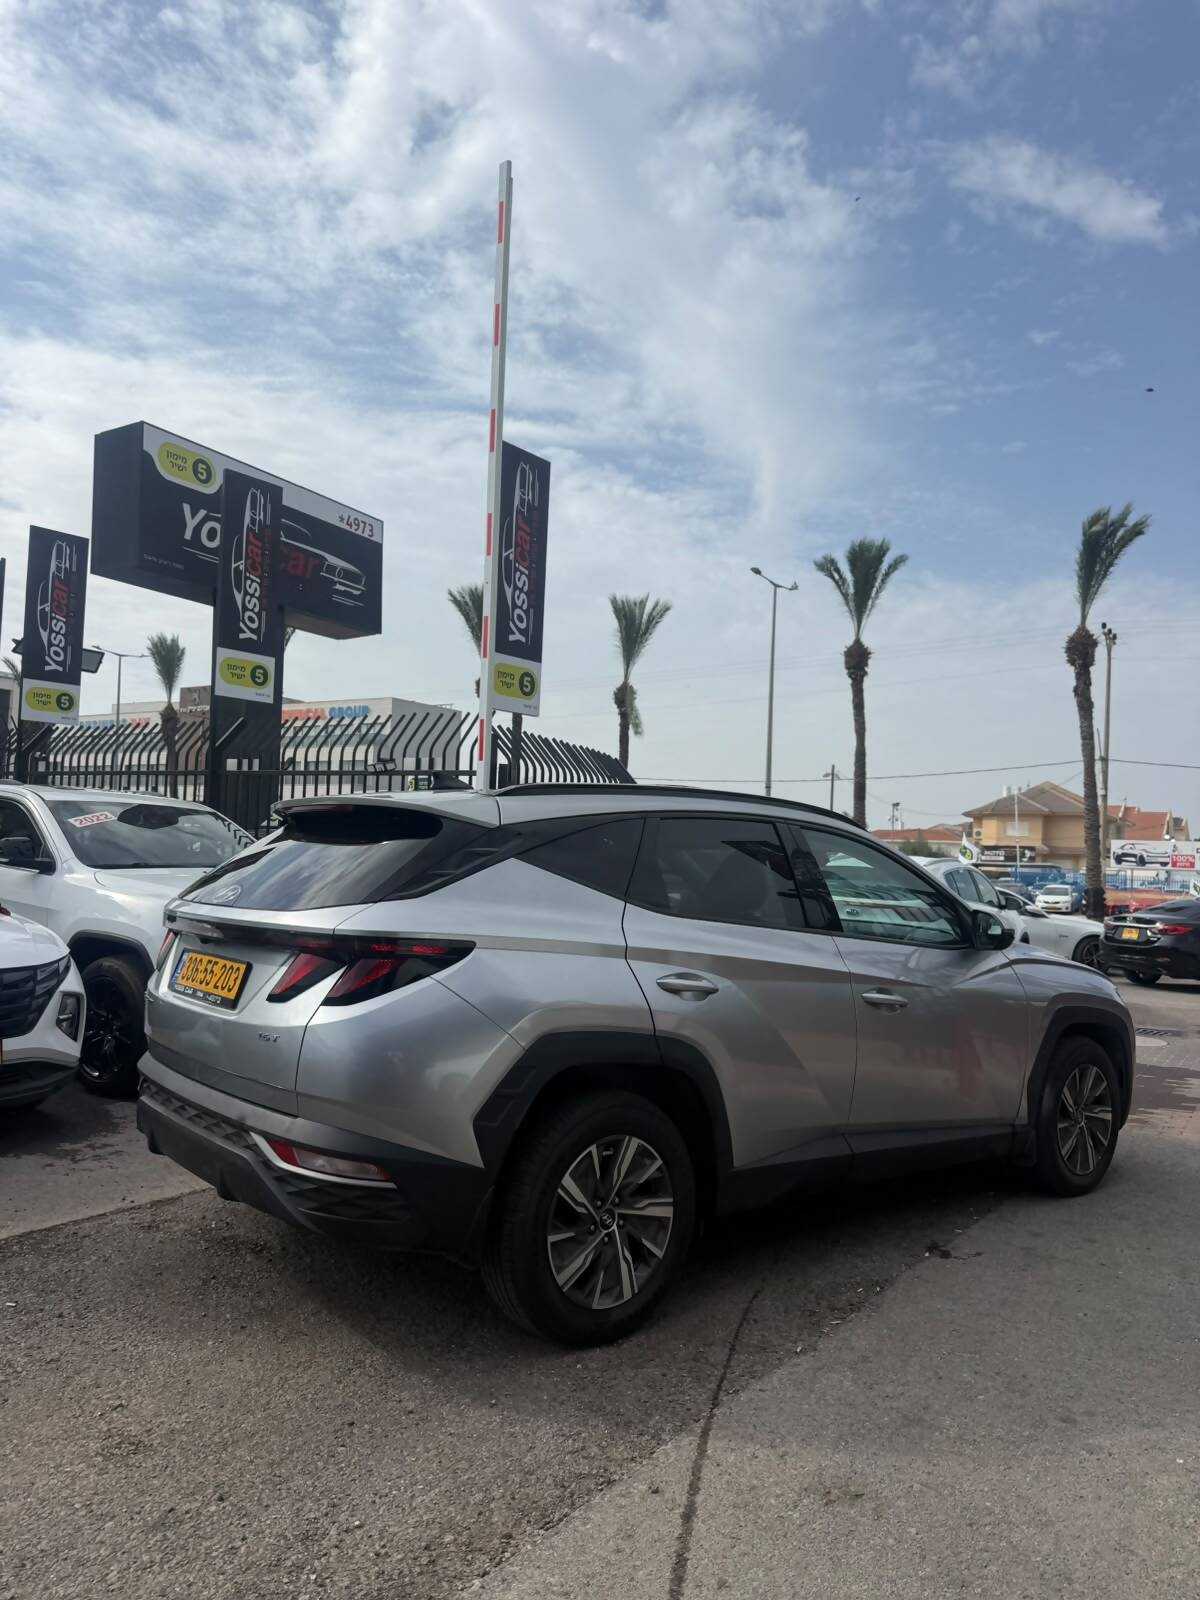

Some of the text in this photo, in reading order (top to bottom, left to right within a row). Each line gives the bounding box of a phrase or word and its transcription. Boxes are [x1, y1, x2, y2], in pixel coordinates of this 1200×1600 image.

[166, 449, 187, 464] מימון
[169, 460, 187, 472] ישיר
[227, 663, 246, 672] מימון
[230, 672, 246, 680] ישיר
[497, 671, 515, 681] מימון
[499, 680, 515, 689] ישיר
[74, 813, 112, 825] 2022
[1172, 855, 1195, 863] 100%
